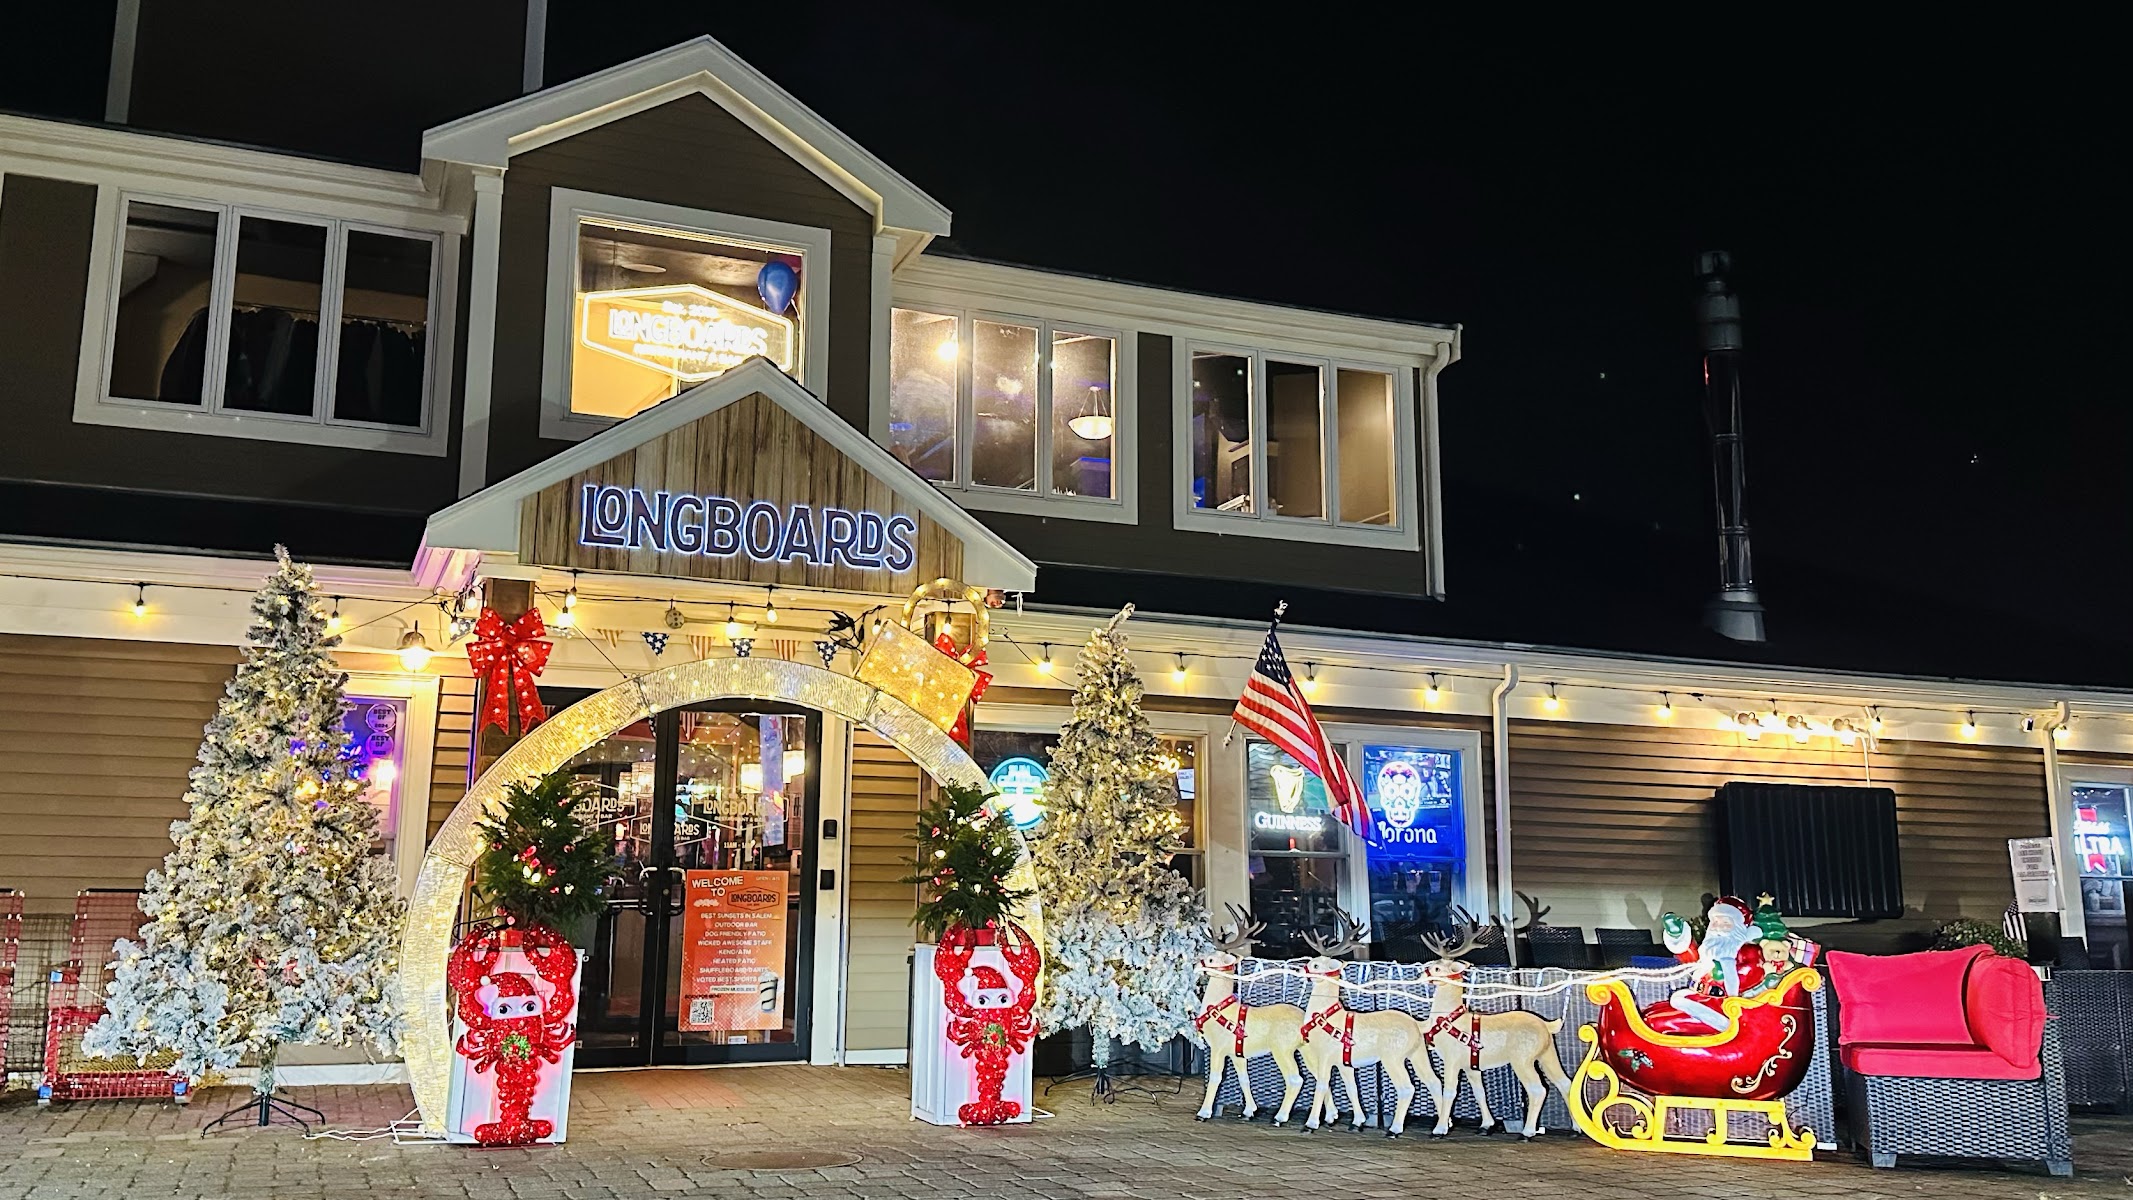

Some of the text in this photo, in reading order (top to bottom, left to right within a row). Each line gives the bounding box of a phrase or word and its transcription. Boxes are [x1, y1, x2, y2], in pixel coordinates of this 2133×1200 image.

[609, 308, 769, 354] LONGBOARDS
[580, 484, 916, 573] LONGBOARDS
[1255, 811, 1323, 831] GUINNESS
[692, 876, 744, 889] WELCOME
[710, 888, 726, 897] TO
[731, 893, 776, 903] LONGBOARDS
